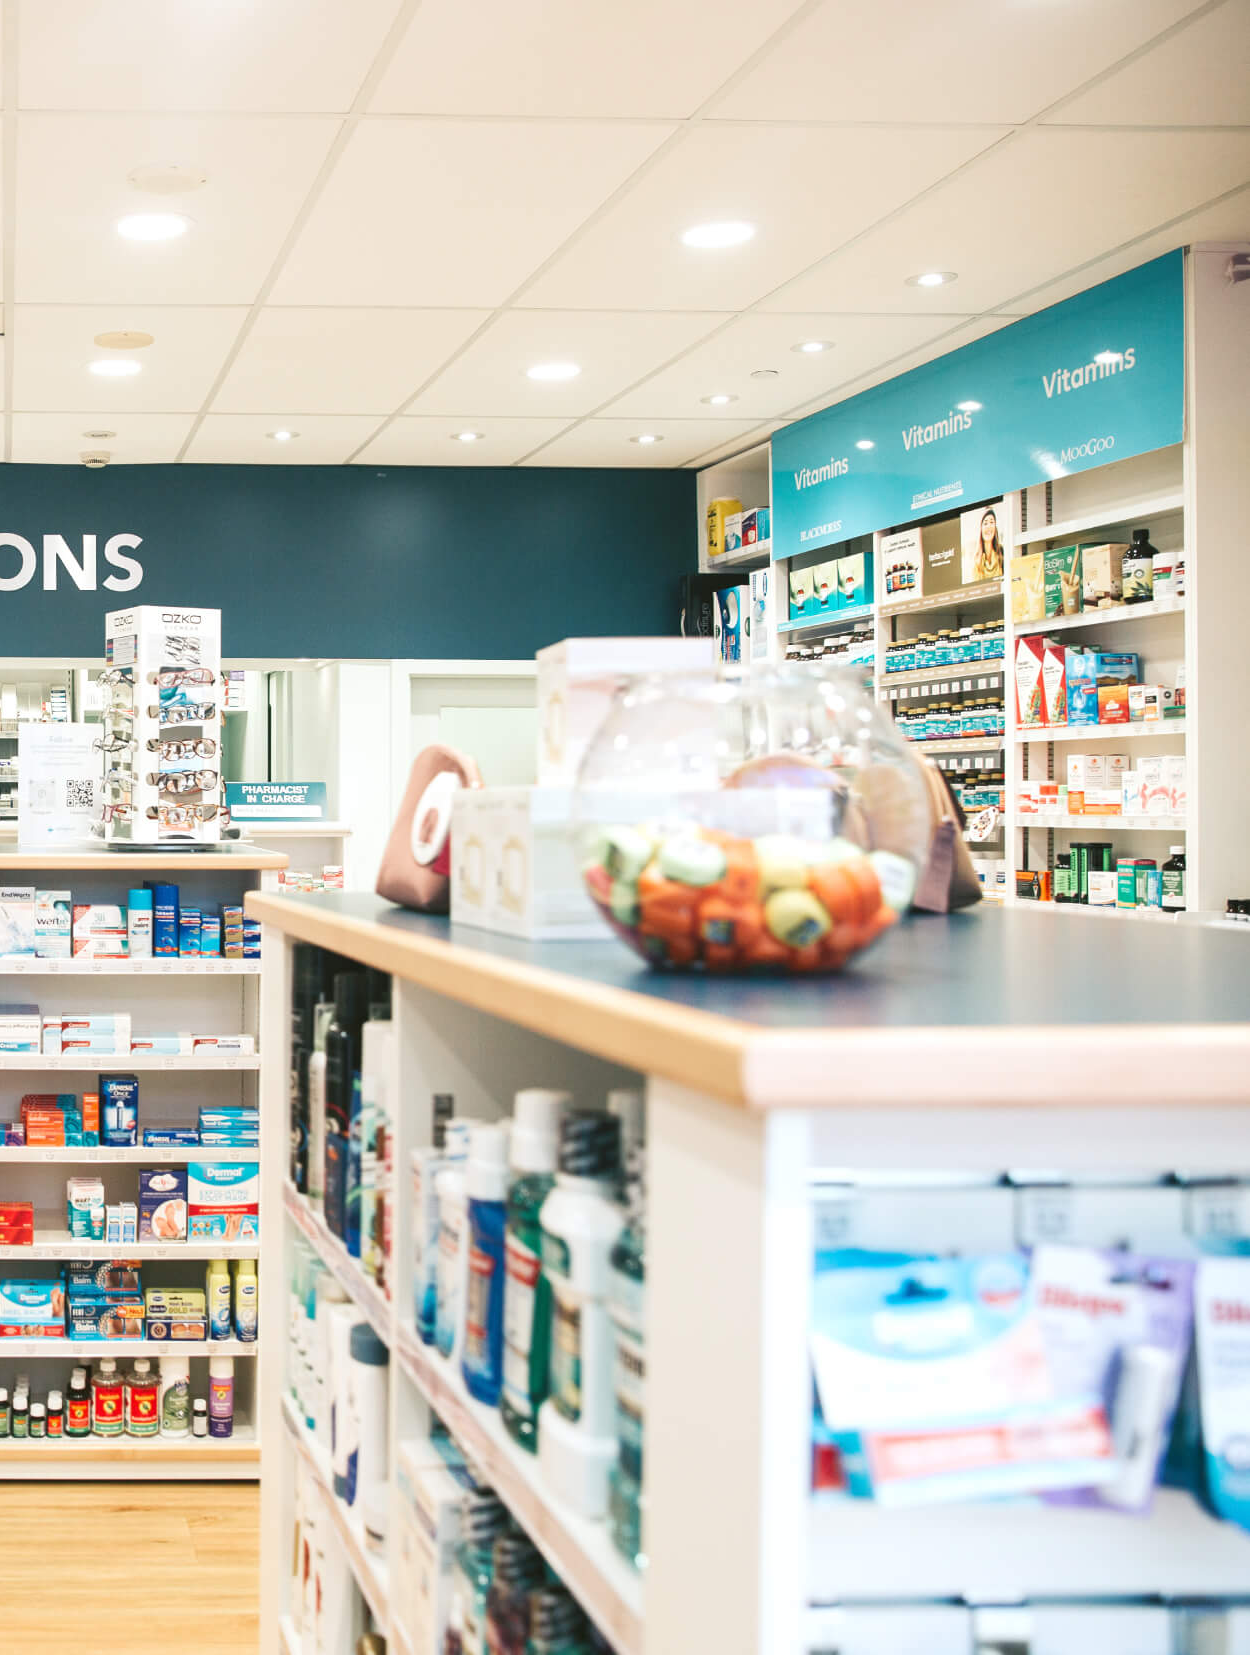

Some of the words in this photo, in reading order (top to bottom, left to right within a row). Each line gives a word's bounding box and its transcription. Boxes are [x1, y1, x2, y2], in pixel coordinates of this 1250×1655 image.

[1042, 347, 1136, 398] Vitamins
[902, 410, 973, 451] Vitamins
[794, 456, 849, 491] Vitamins
[161, 613, 202, 625] OZKO
[241, 785, 309, 794] PHARMACIST
[246, 795, 257, 803] IN
[261, 795, 306, 803] CHARGE
